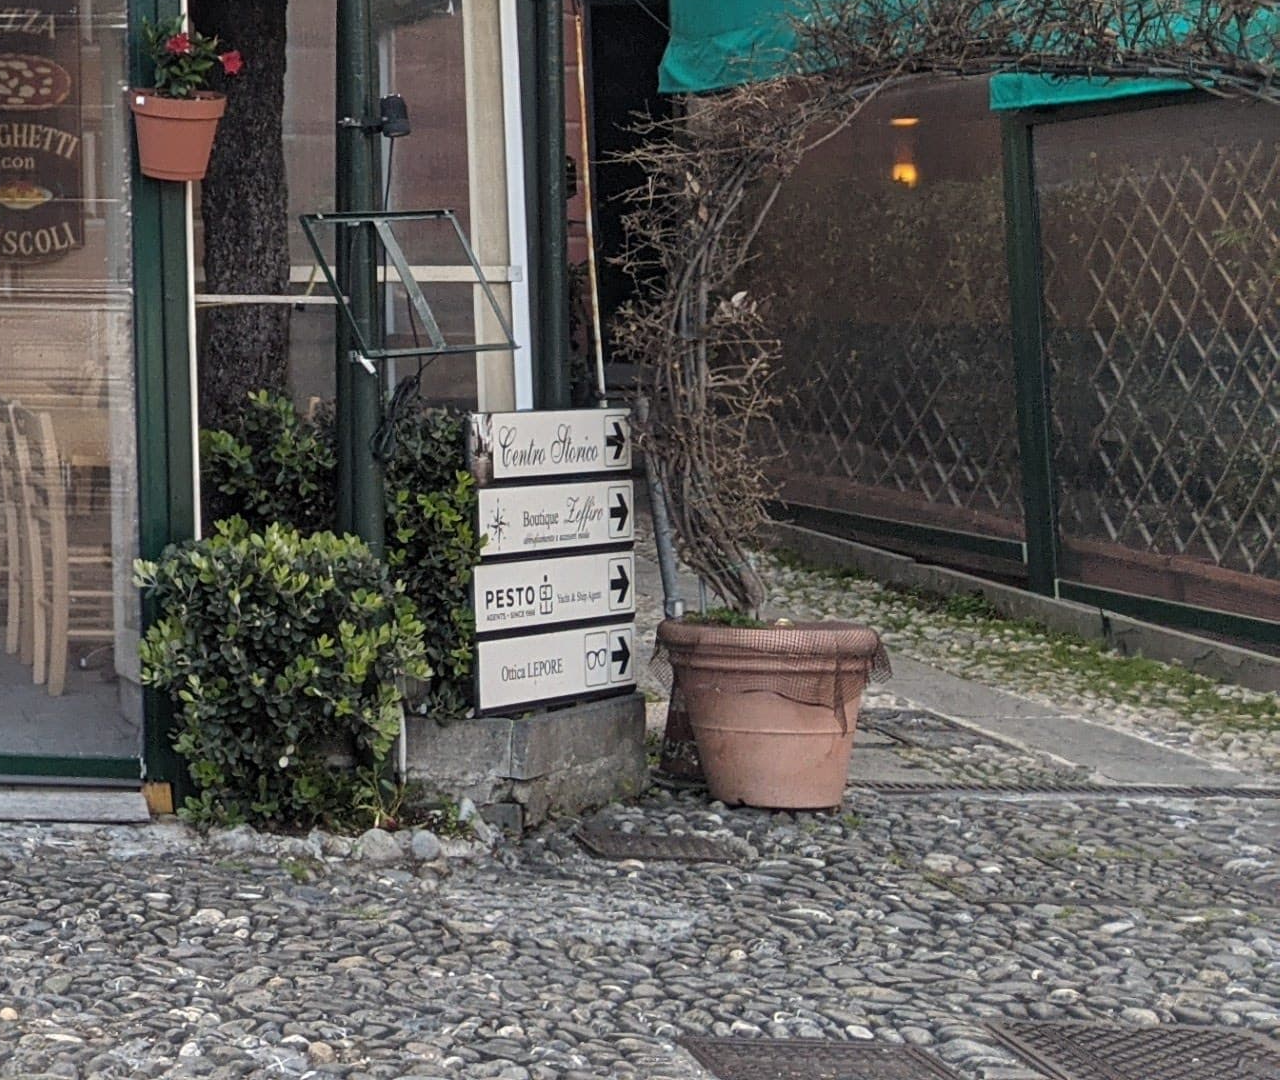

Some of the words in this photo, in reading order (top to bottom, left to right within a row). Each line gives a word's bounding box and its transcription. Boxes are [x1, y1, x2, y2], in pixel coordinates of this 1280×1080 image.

[1, 157, 35, 170] con
[498, 425, 546, 468] Centro
[550, 423, 599, 464] Storico
[523, 508, 559, 530] Boutique
[485, 585, 535, 610] PESTO
[501, 664, 526, 682] Ottica
[527, 658, 564, 678] LEPORE
